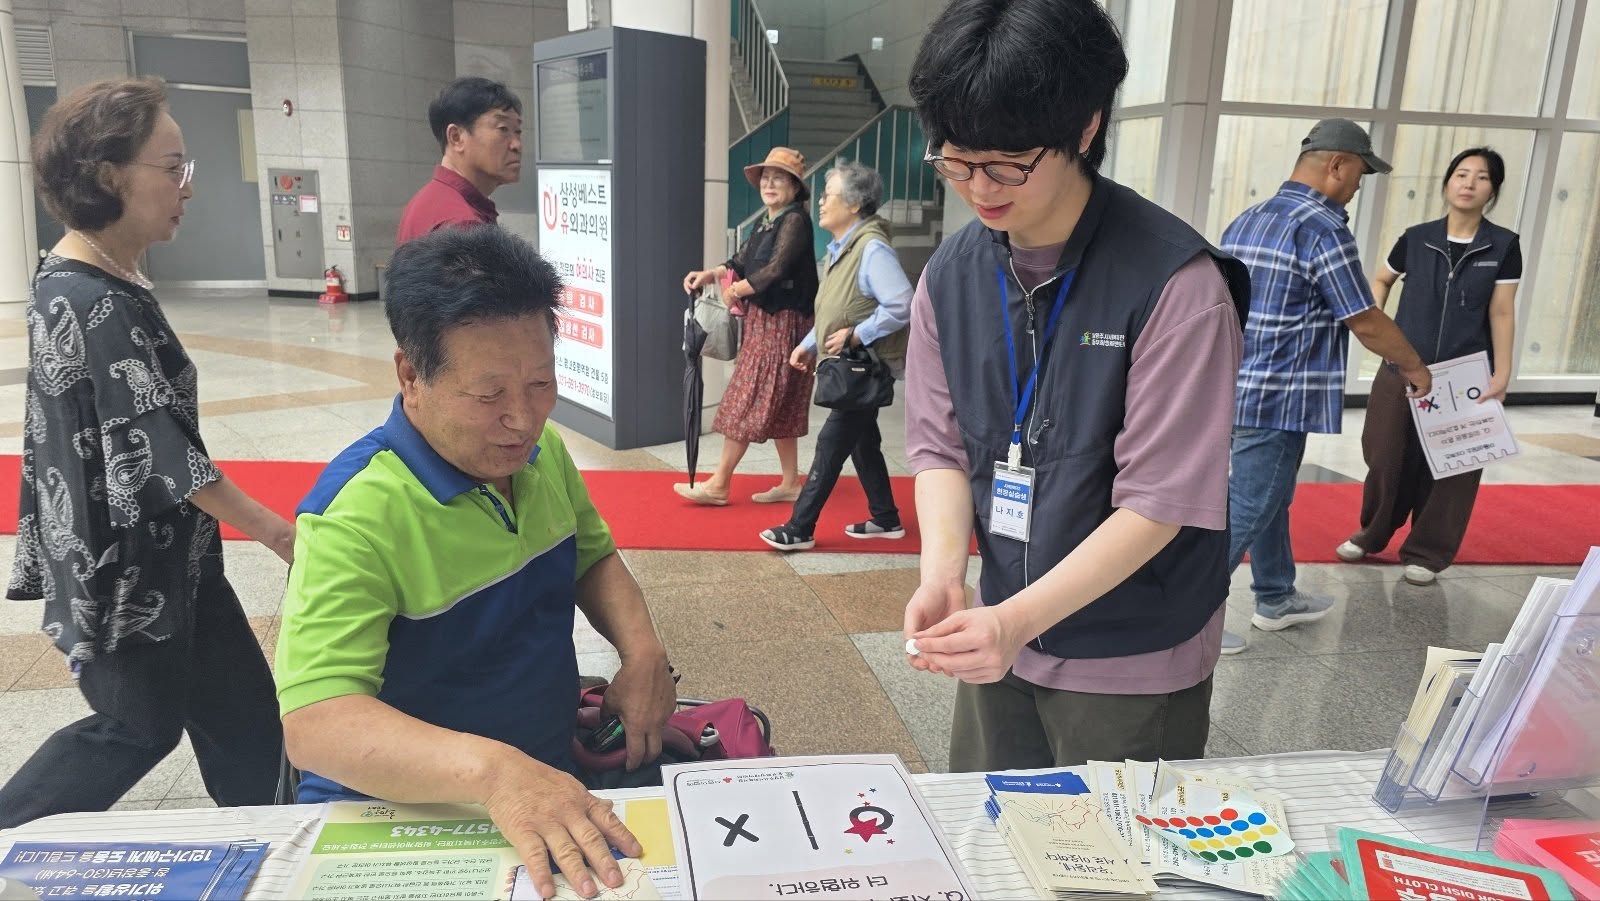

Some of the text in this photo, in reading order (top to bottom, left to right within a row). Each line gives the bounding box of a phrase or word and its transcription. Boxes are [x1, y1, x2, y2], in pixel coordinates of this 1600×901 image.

[560, 182, 607, 208] 삼성베스트
[561, 211, 607, 241] 유외과의원
[390, 823, 499, 837] 1577-4343
[13, 848, 213, 863] 1인가구에게 도움을 드립니다!
[85, 883, 164, 897] 위기상황을
[768, 875, 888, 896] 더 위험하다.
[1393, 876, 1438, 891] CLOTH
[1441, 885, 1475, 899] DISH
